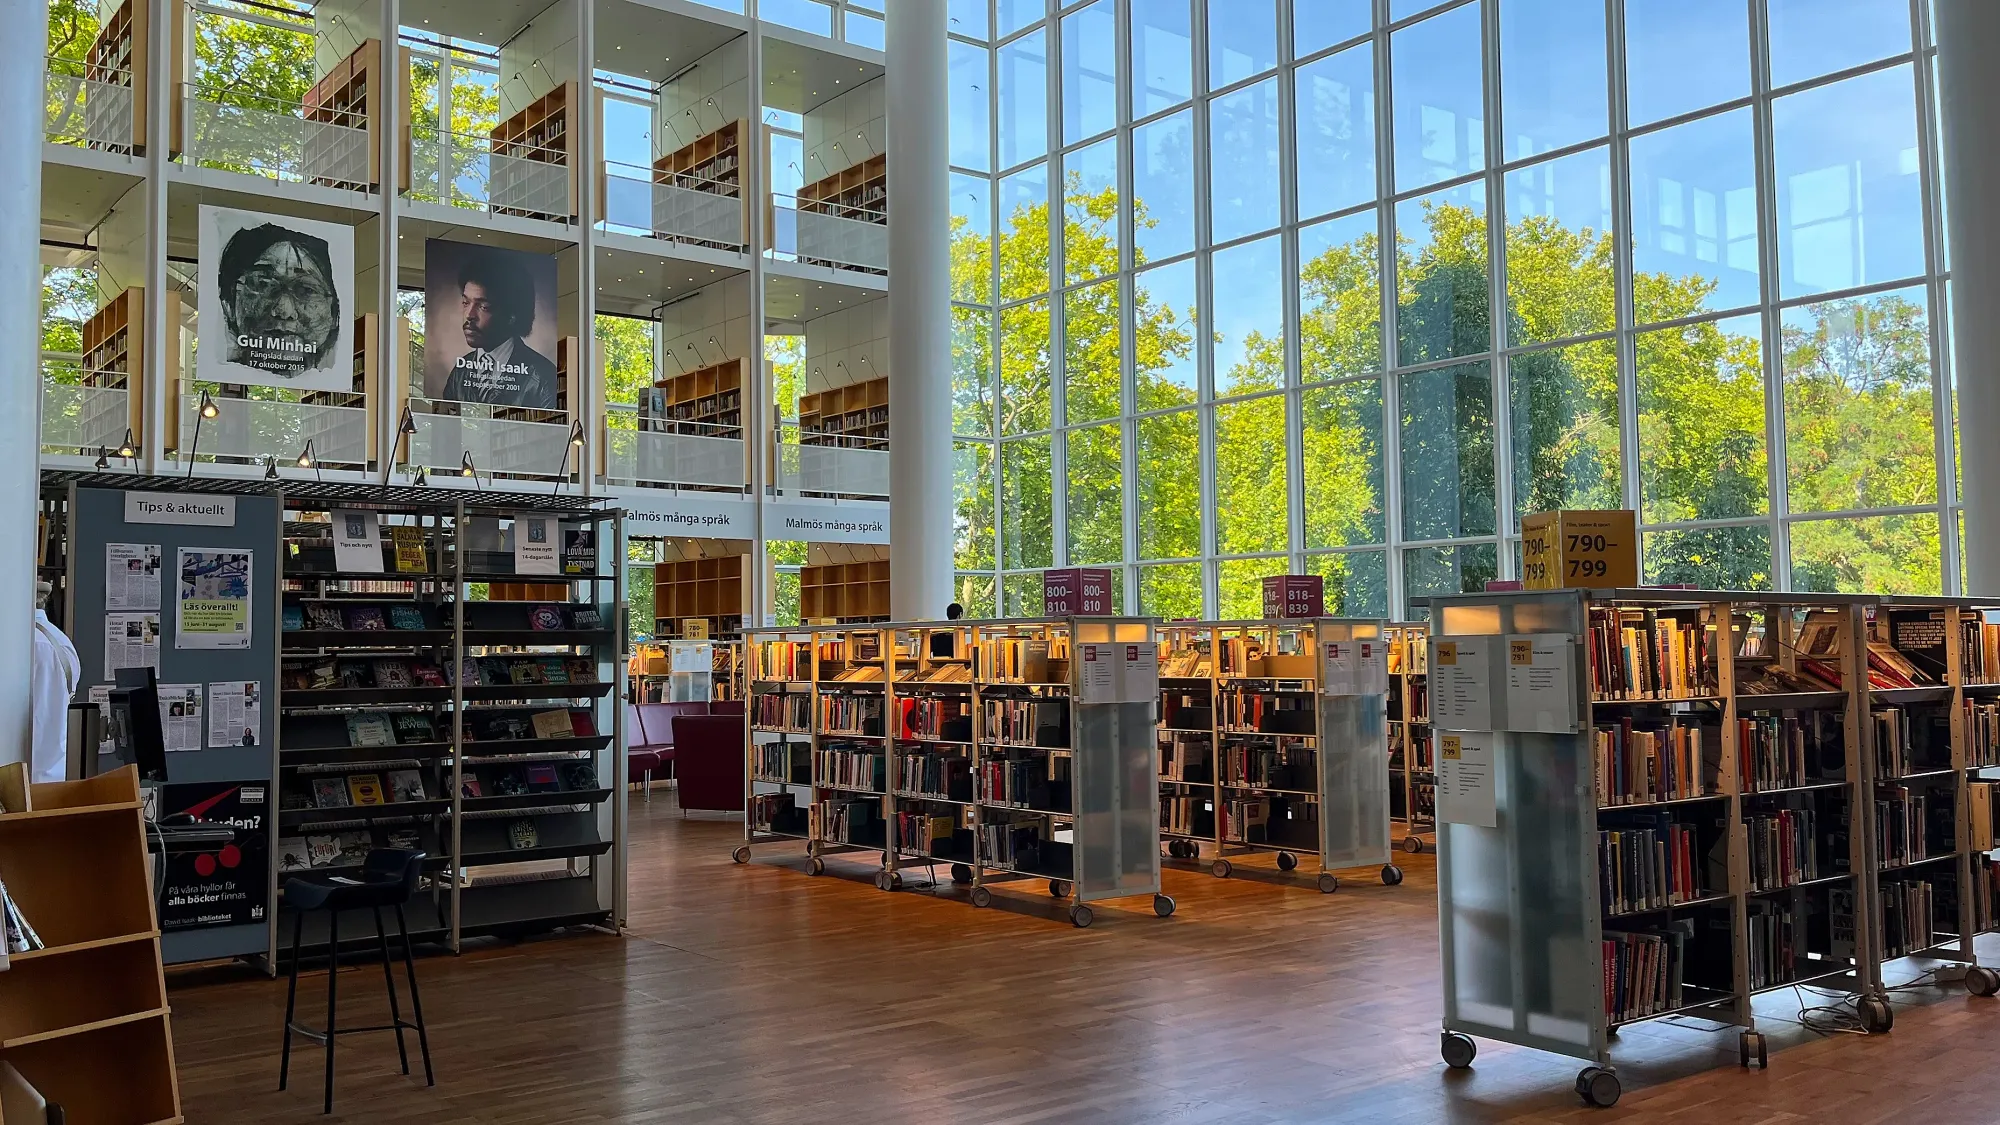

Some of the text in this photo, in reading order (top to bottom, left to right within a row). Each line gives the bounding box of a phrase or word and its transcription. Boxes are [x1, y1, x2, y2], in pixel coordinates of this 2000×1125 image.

[238, 335, 316, 354] Gui Minhai
[250, 351, 282, 360] Fängslad
[259, 361, 286, 370] oktober
[456, 357, 528, 375] Dawit Isaak
[472, 381, 505, 390] september
[137, 501, 225, 515] Tips & aktuellt
[628, 510, 730, 526] almös många språk
[786, 518, 882, 533] Malmös många språk
[1526, 562, 1545, 580] 799
[1569, 560, 1606, 577] 799
[201, 602, 238, 611] överallt!
[1047, 601, 1066, 612] 810
[1084, 600, 1100, 611] 810
[1264, 605, 1276, 614] 839
[1289, 604, 1308, 614] 839
[169, 881, 236, 895] På våra hyllor får
[168, 892, 246, 906] alla böcker finnas
